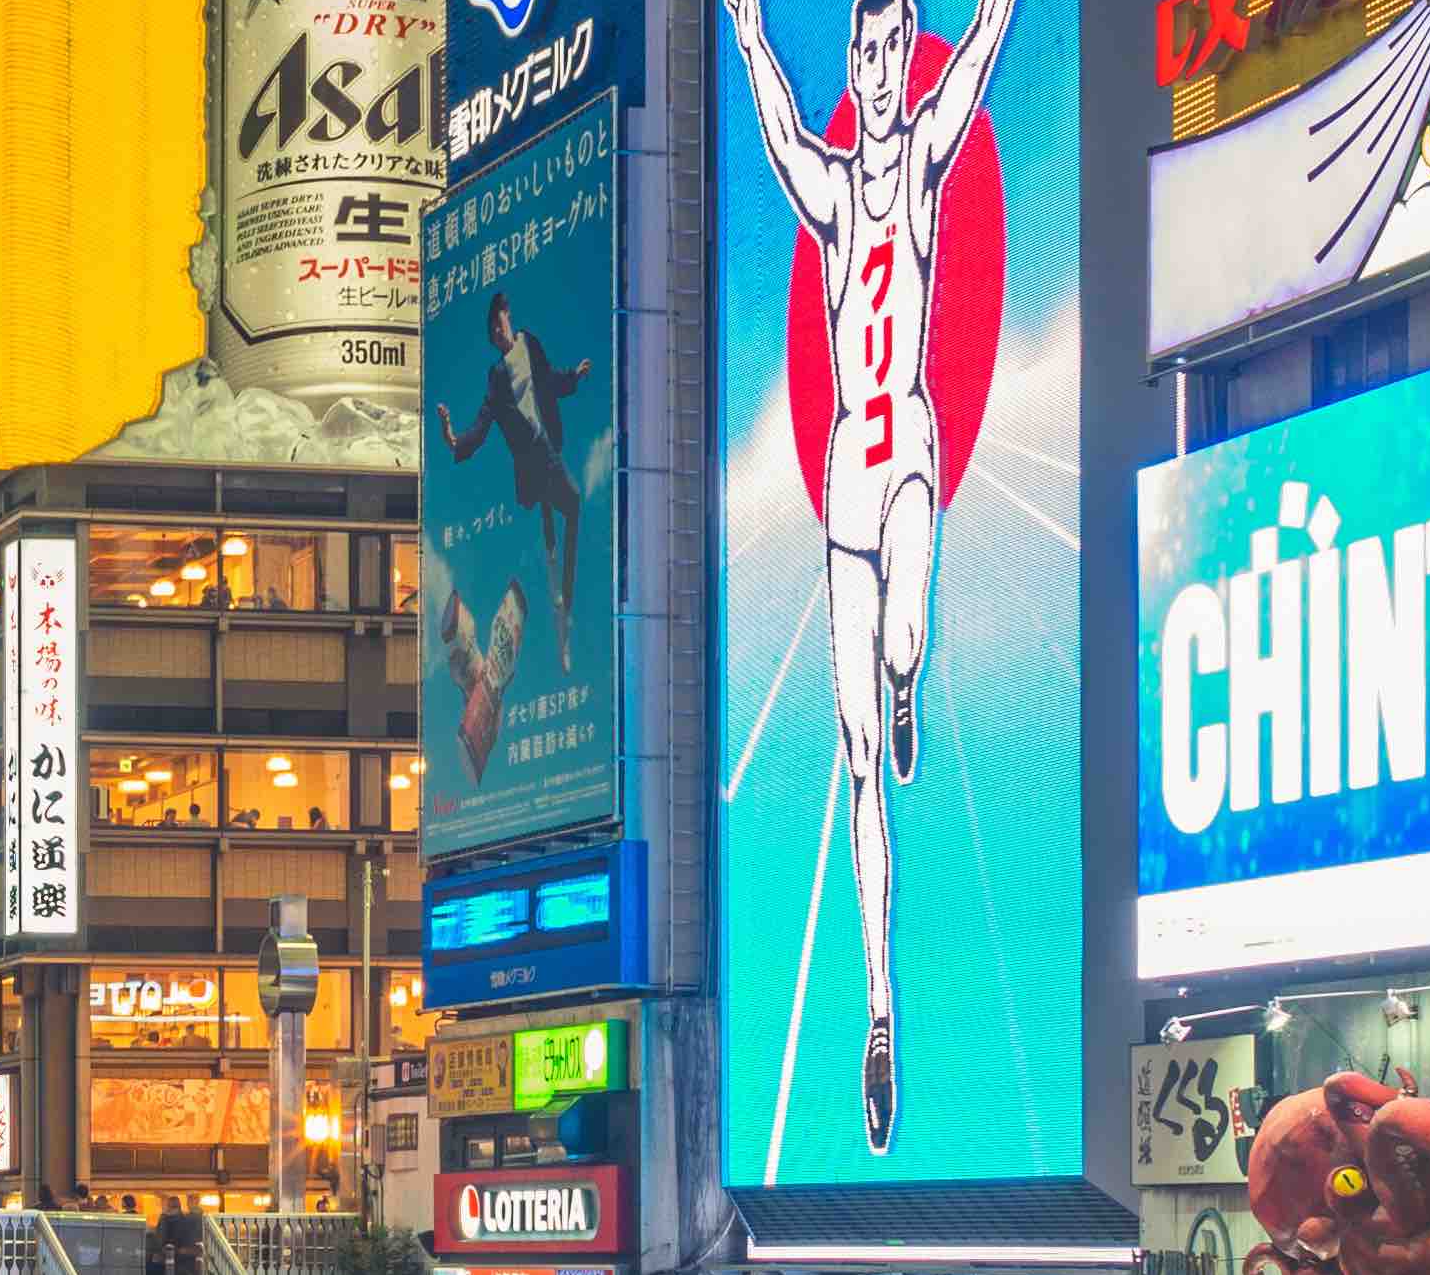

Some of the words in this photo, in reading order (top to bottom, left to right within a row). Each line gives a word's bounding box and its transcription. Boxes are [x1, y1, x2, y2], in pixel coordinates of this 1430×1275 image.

[447, 18, 594, 160] 雪印メグミルク
[334, 192, 412, 245] 生
[424, 124, 611, 264] 道頓堀のおいしいものと
[341, 339, 406, 367] 350ml
[860, 223, 895, 469] グリコ
[32, 602, 64, 726] 本場の味
[482, 1188, 587, 1233] LOTTERIA
